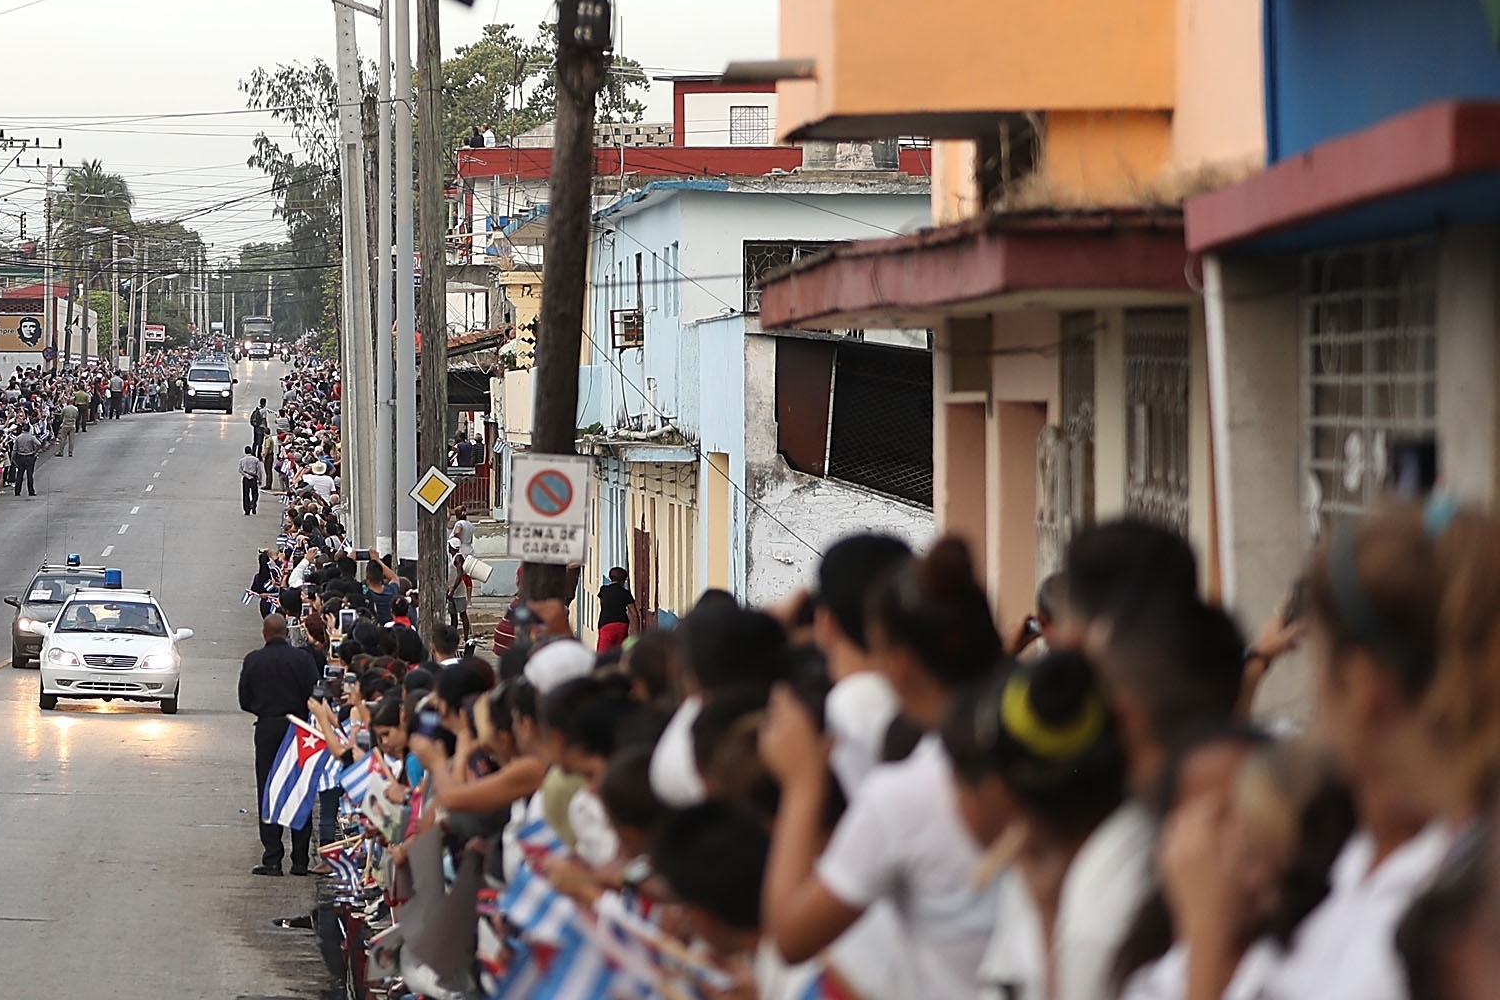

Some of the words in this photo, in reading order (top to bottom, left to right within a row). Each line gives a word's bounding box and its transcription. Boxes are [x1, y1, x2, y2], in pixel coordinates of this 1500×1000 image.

[512, 526, 554, 540] ZONA
[560, 528, 577, 541] DE
[522, 541, 570, 554] CARGA
